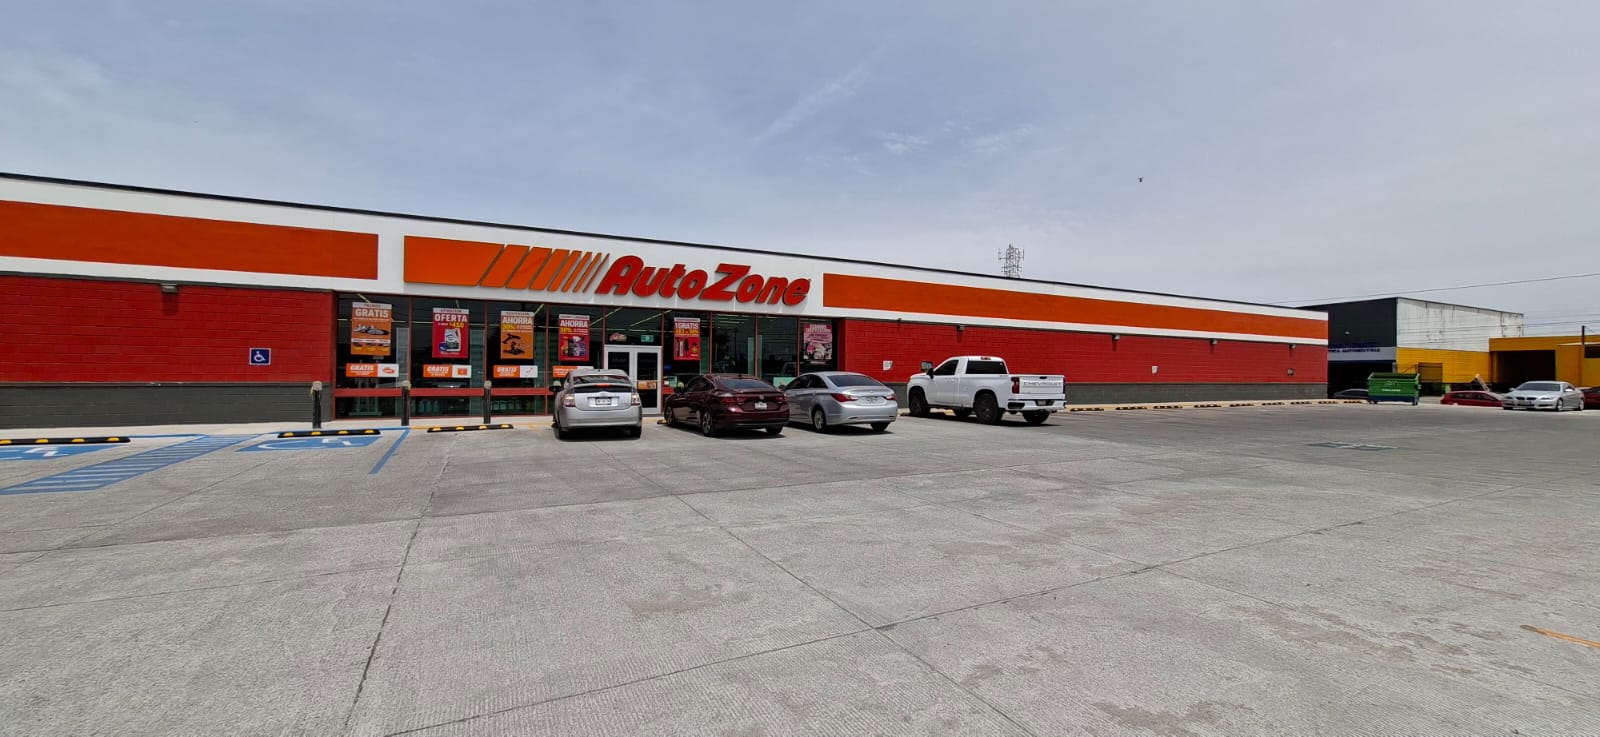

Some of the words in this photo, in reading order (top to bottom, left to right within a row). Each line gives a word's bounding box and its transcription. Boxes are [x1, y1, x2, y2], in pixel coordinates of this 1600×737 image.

[594, 255, 811, 307] AutoZone
[355, 308, 389, 318] GRATIS
[434, 313, 467, 322] OFERTA
[502, 316, 533, 325] AHORRA
[560, 319, 588, 328] AHORRA
